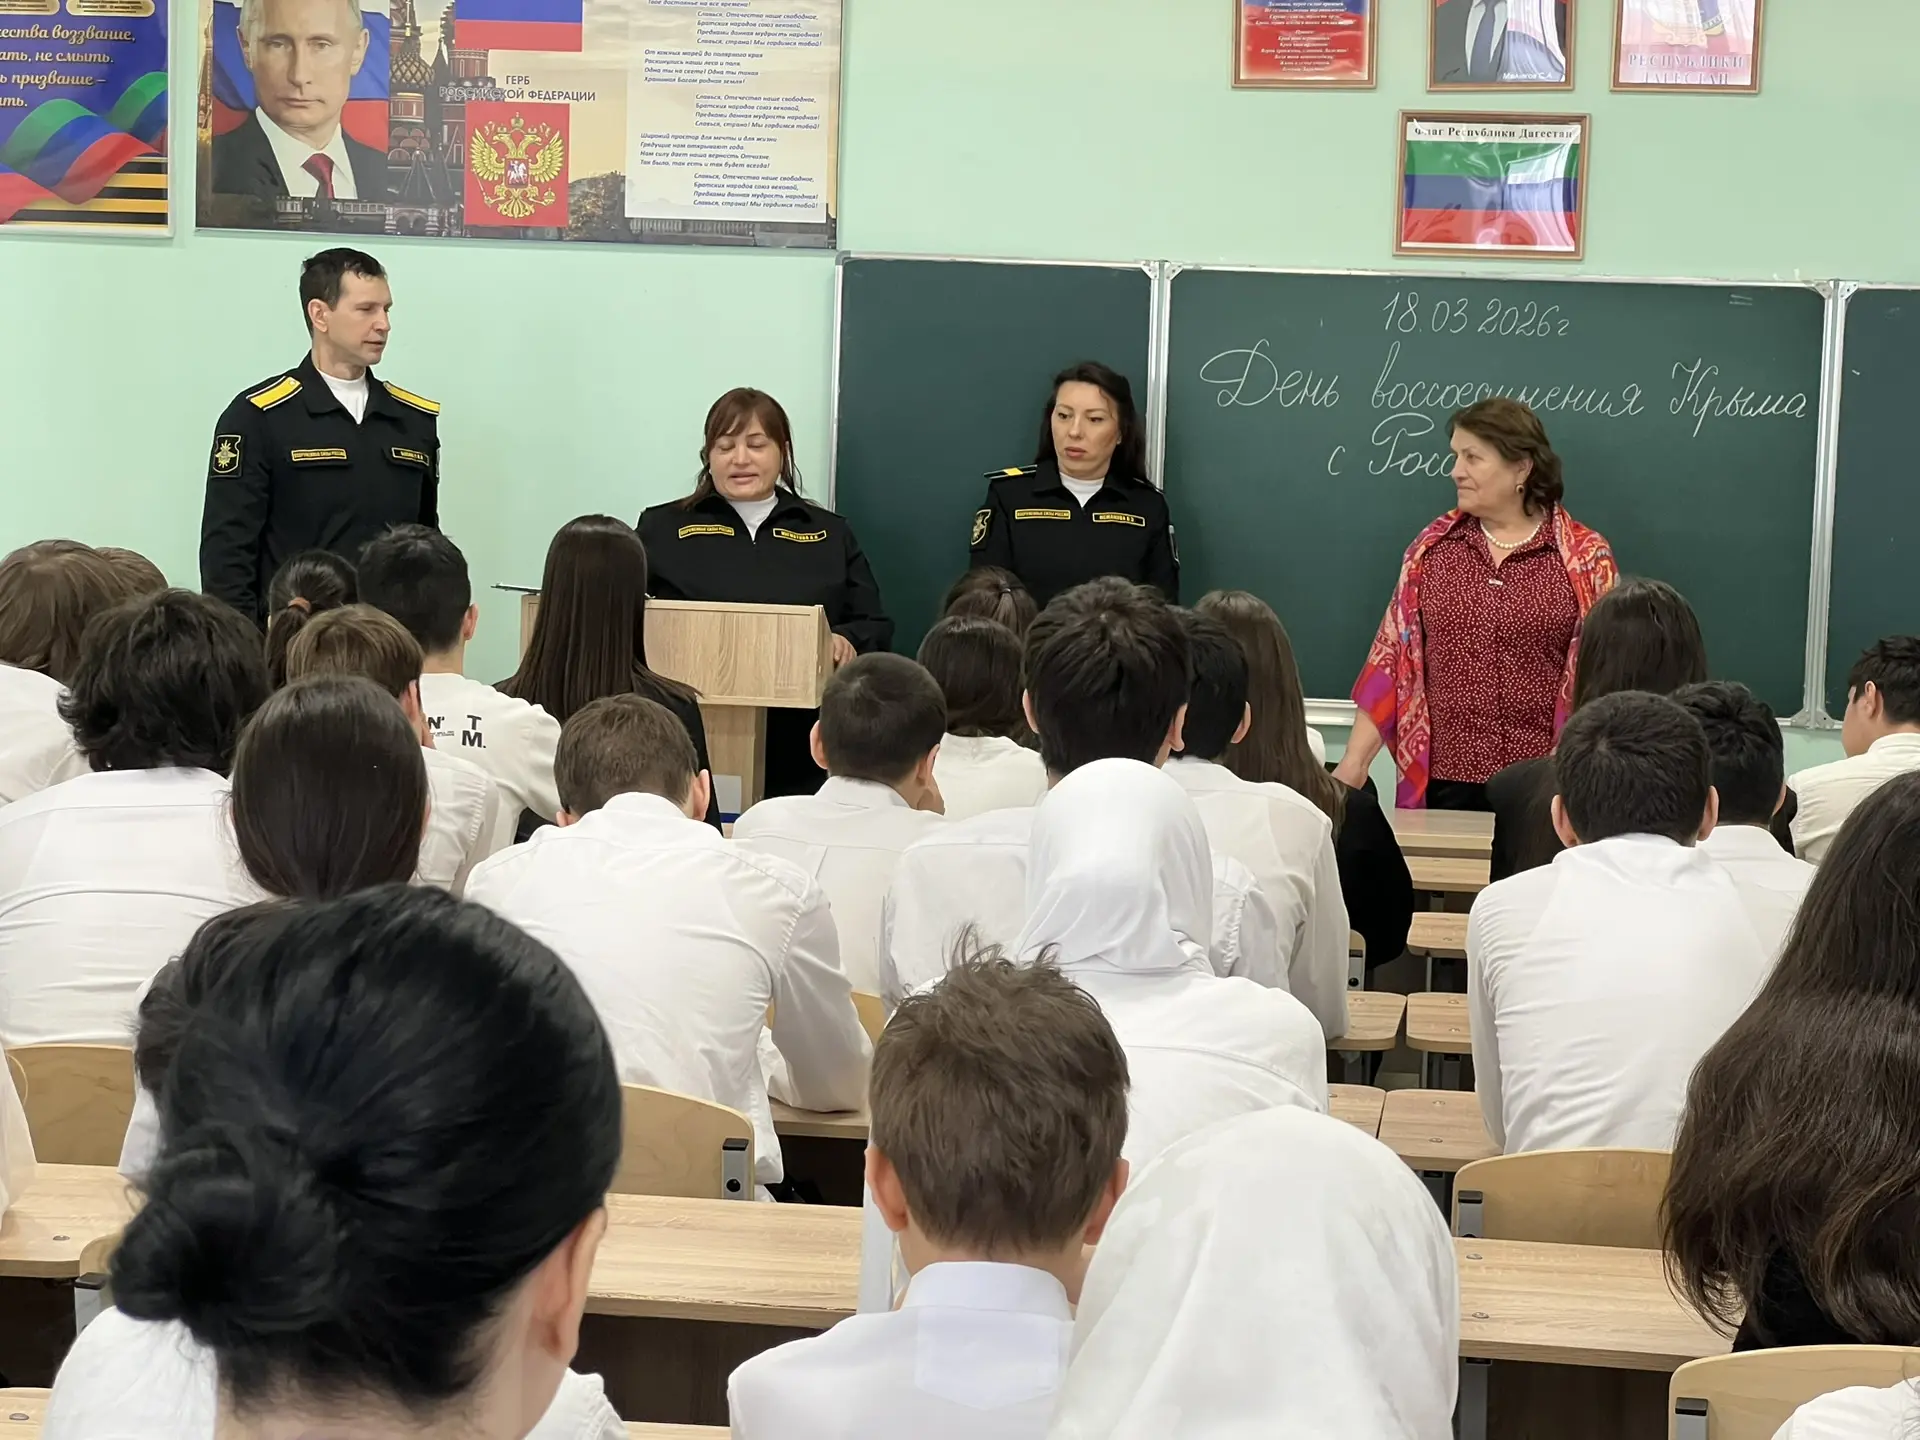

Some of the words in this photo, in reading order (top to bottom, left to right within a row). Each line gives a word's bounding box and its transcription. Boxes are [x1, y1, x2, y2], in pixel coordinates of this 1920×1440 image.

[0, 24, 49, 38] ества
[52, 24, 136, 44] воззвание,
[35, 52, 53, 62] не
[56, 52, 114, 63] смыть.
[1628, 54, 1744, 70] РЕСПУБЛИКИ
[11, 70, 94, 89] призвание
[506, 75, 530, 85] ГЕРБ
[439, 86, 524, 100] РОССИЙСКОЙ
[528, 89, 595, 102] ФЕДЕРАЦИИ
[1518, 128, 1573, 140] Дагестан
[1200, 339, 1340, 407] День
[1669, 358, 1807, 437] Крыма
[1327, 446, 1346, 476] с
[462, 730, 487, 748] M.
